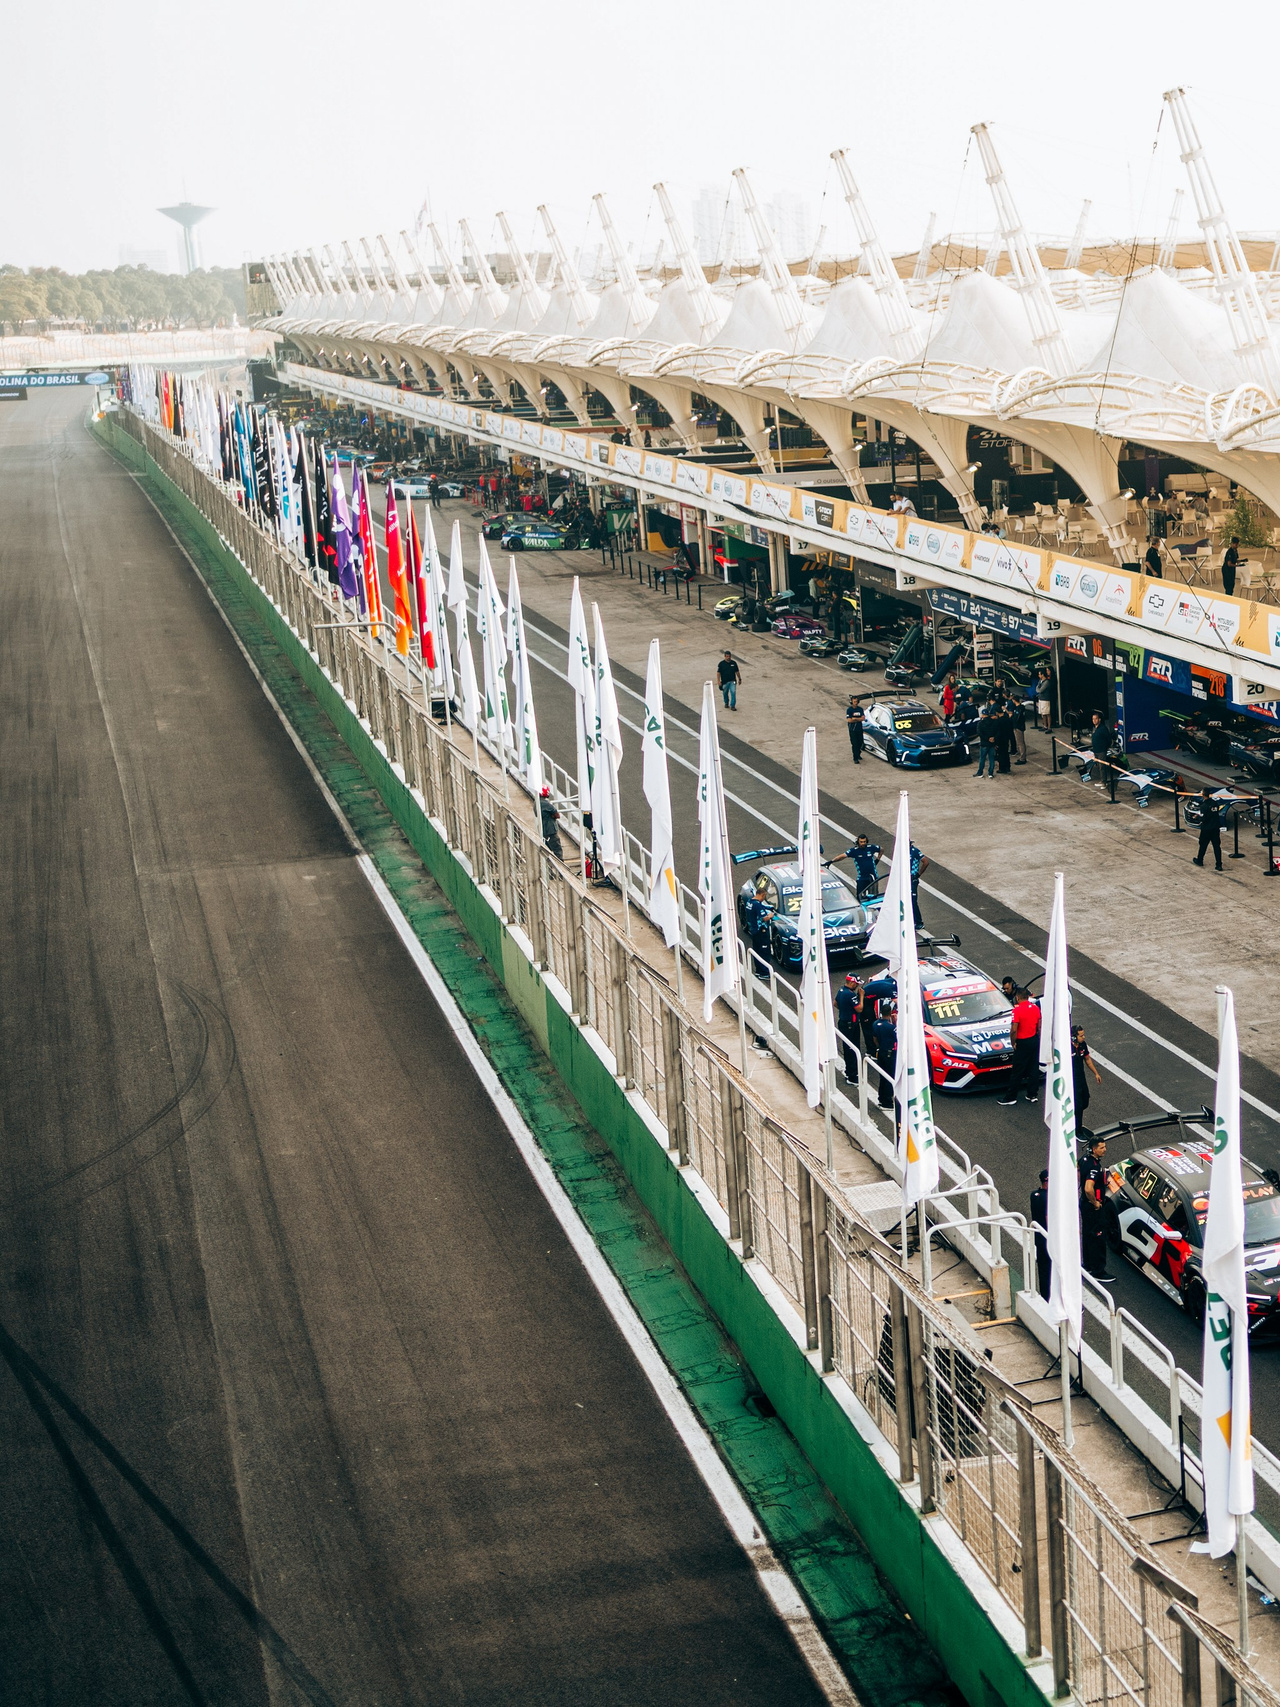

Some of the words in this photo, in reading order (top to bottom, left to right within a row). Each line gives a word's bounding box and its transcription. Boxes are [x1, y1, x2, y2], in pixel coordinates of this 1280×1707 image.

[30, 376, 45, 385] DO
[46, 375, 80, 385] BRASIL
[997, 556, 1008, 569] vivo
[903, 576, 916, 585] 18
[1060, 573, 1070, 589] BRB
[960, 599, 968, 612] 17
[970, 602, 981, 617] 24
[1178, 607, 1189, 617] GR
[1008, 615, 1019, 630] 97
[1047, 621, 1061, 631] 19
[1092, 638, 1103, 658] 06
[1129, 647, 1139, 668] 82
[1209, 674, 1225, 698] 218
[1247, 684, 1265, 695] 20
[894, 711, 933, 719] CHEVROLET
[956, 984, 987, 994] ALE
[935, 1004, 960, 1018] 111
[972, 1038, 1012, 1054] Mob
[1144, 1179, 1153, 1190] 7
